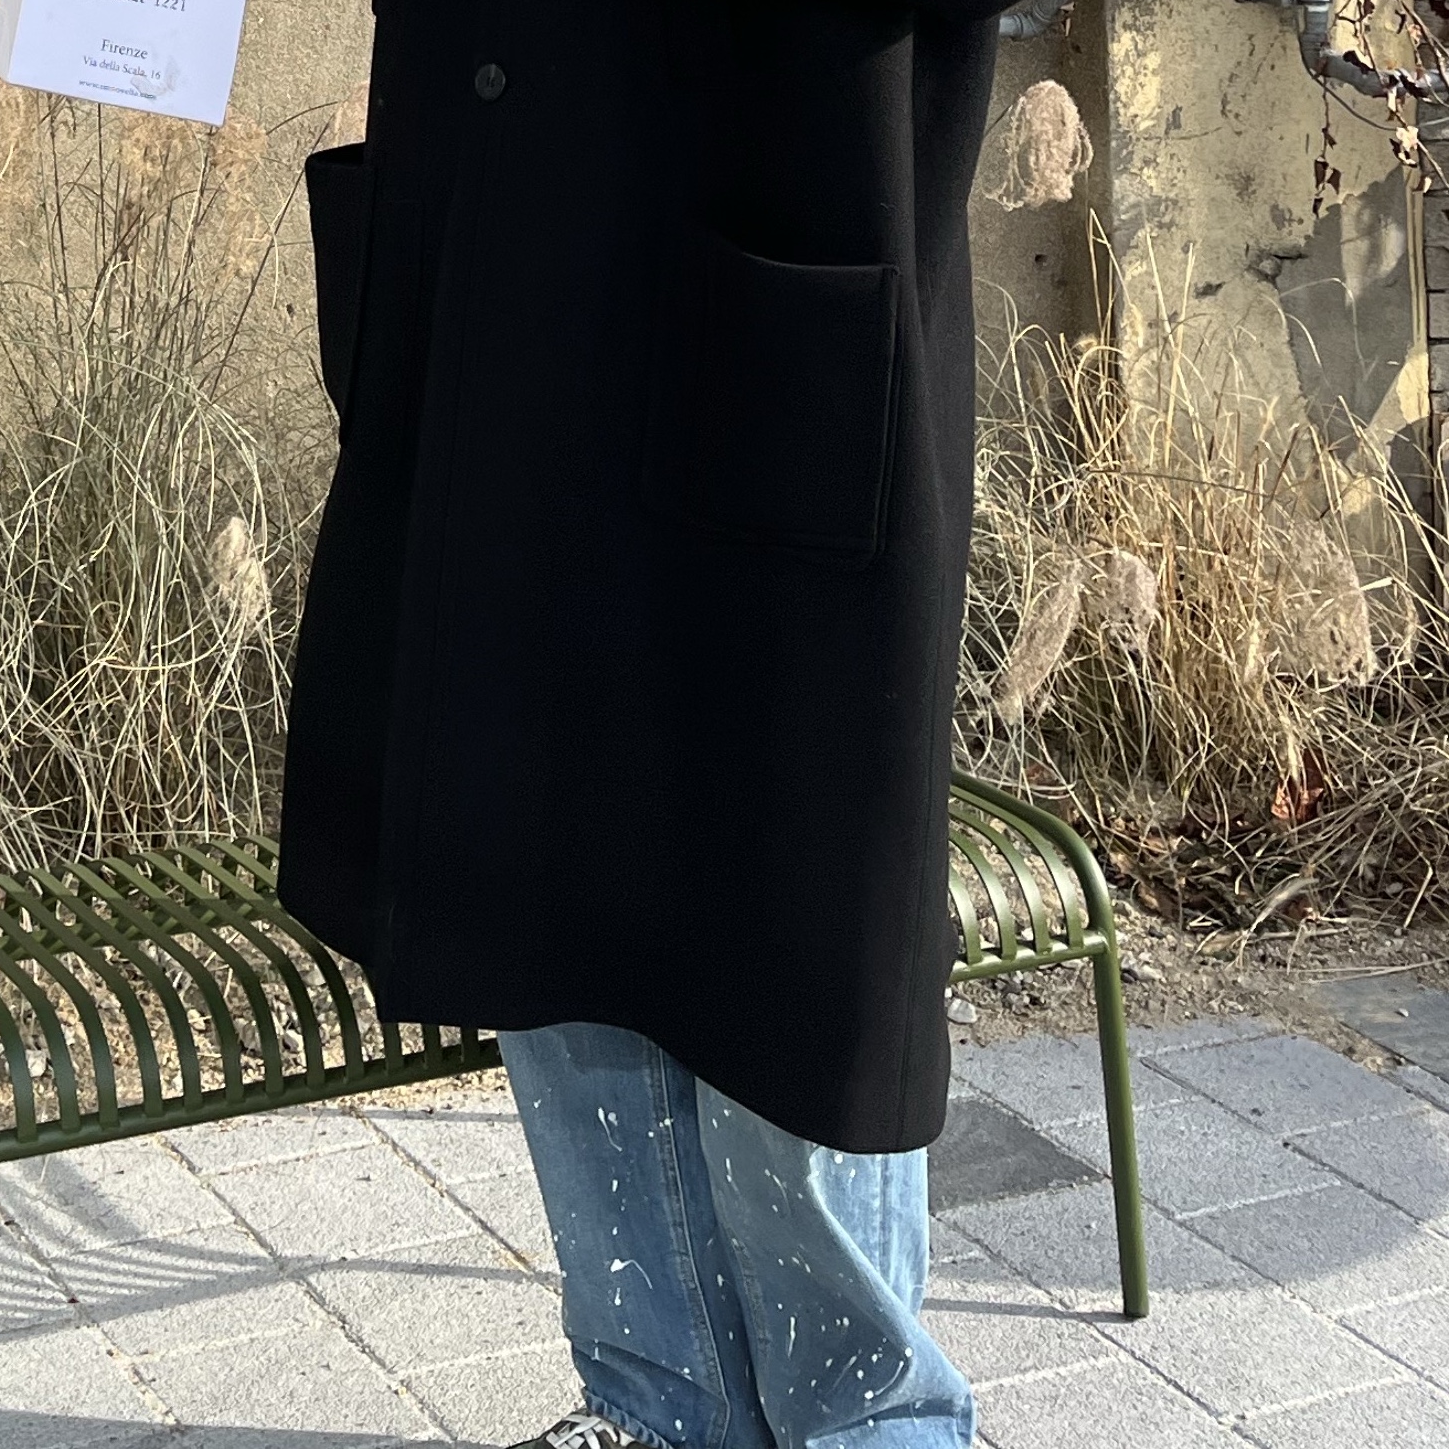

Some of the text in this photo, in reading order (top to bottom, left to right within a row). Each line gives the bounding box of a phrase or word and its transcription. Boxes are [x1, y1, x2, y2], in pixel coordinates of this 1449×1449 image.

[100, 38, 149, 60] Firenze
[83, 55, 97, 68] Via
[99, 59, 120, 72] della
[150, 69, 161, 81] 16
